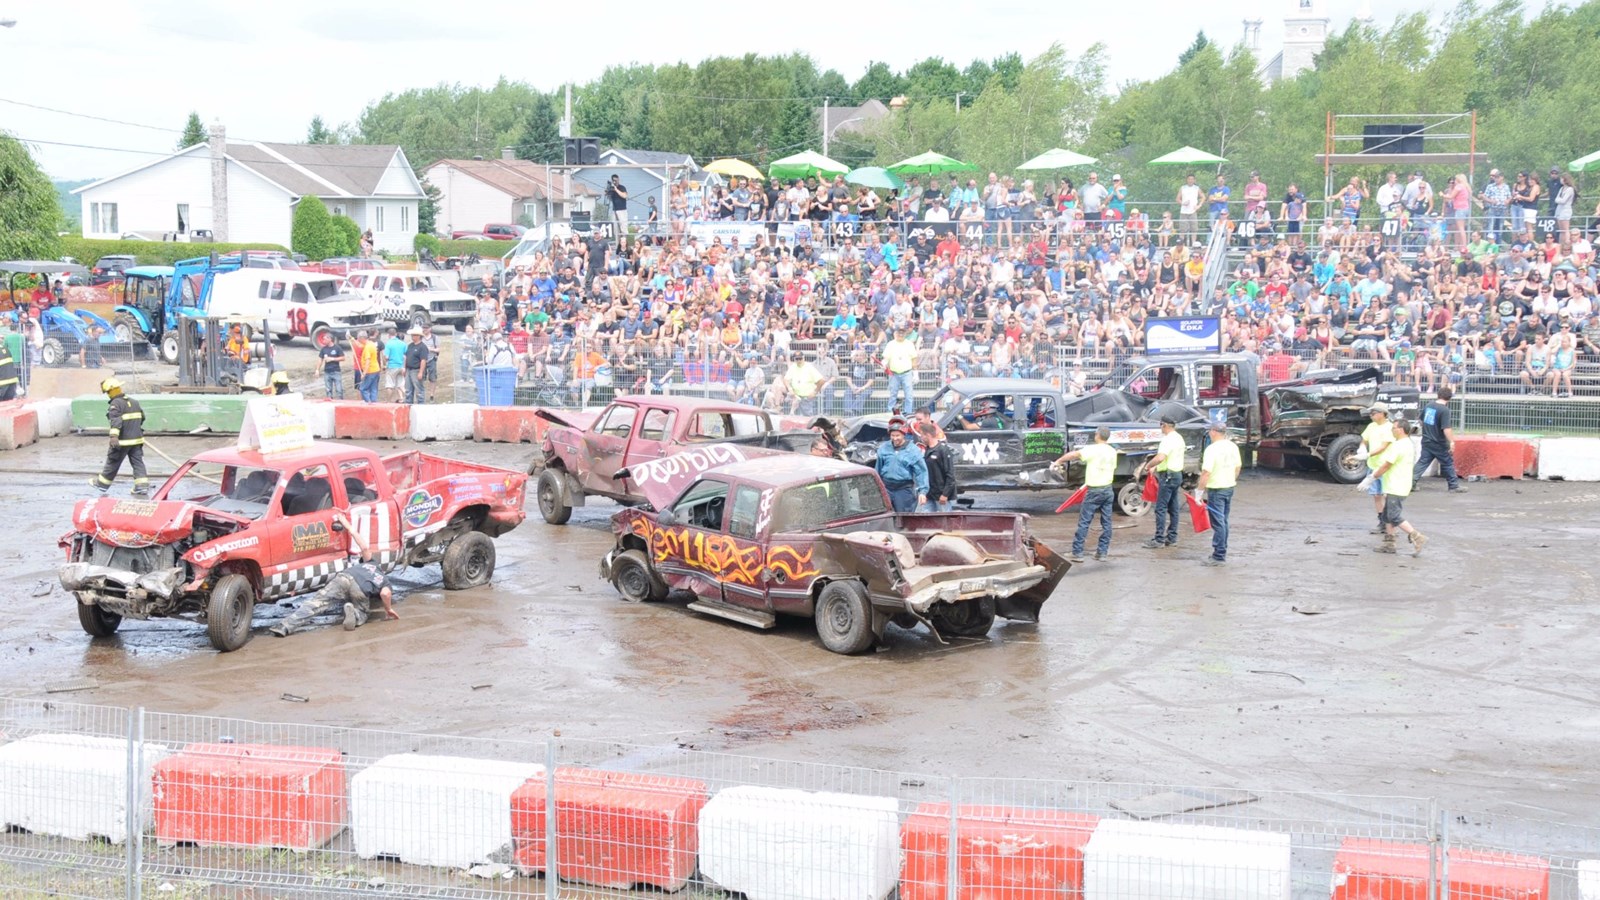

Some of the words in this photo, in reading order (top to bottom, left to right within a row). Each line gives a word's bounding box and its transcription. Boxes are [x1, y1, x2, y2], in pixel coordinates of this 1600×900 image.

[600, 223, 613, 238] 41
[836, 222, 854, 237] 43
[965, 225, 983, 240] 44
[1107, 223, 1124, 238] 45
[1238, 222, 1255, 237] 46
[1382, 220, 1398, 236] 47
[1538, 219, 1556, 232] 48
[287, 308, 309, 337] 18
[406, 498, 440, 514] MONDIAL
